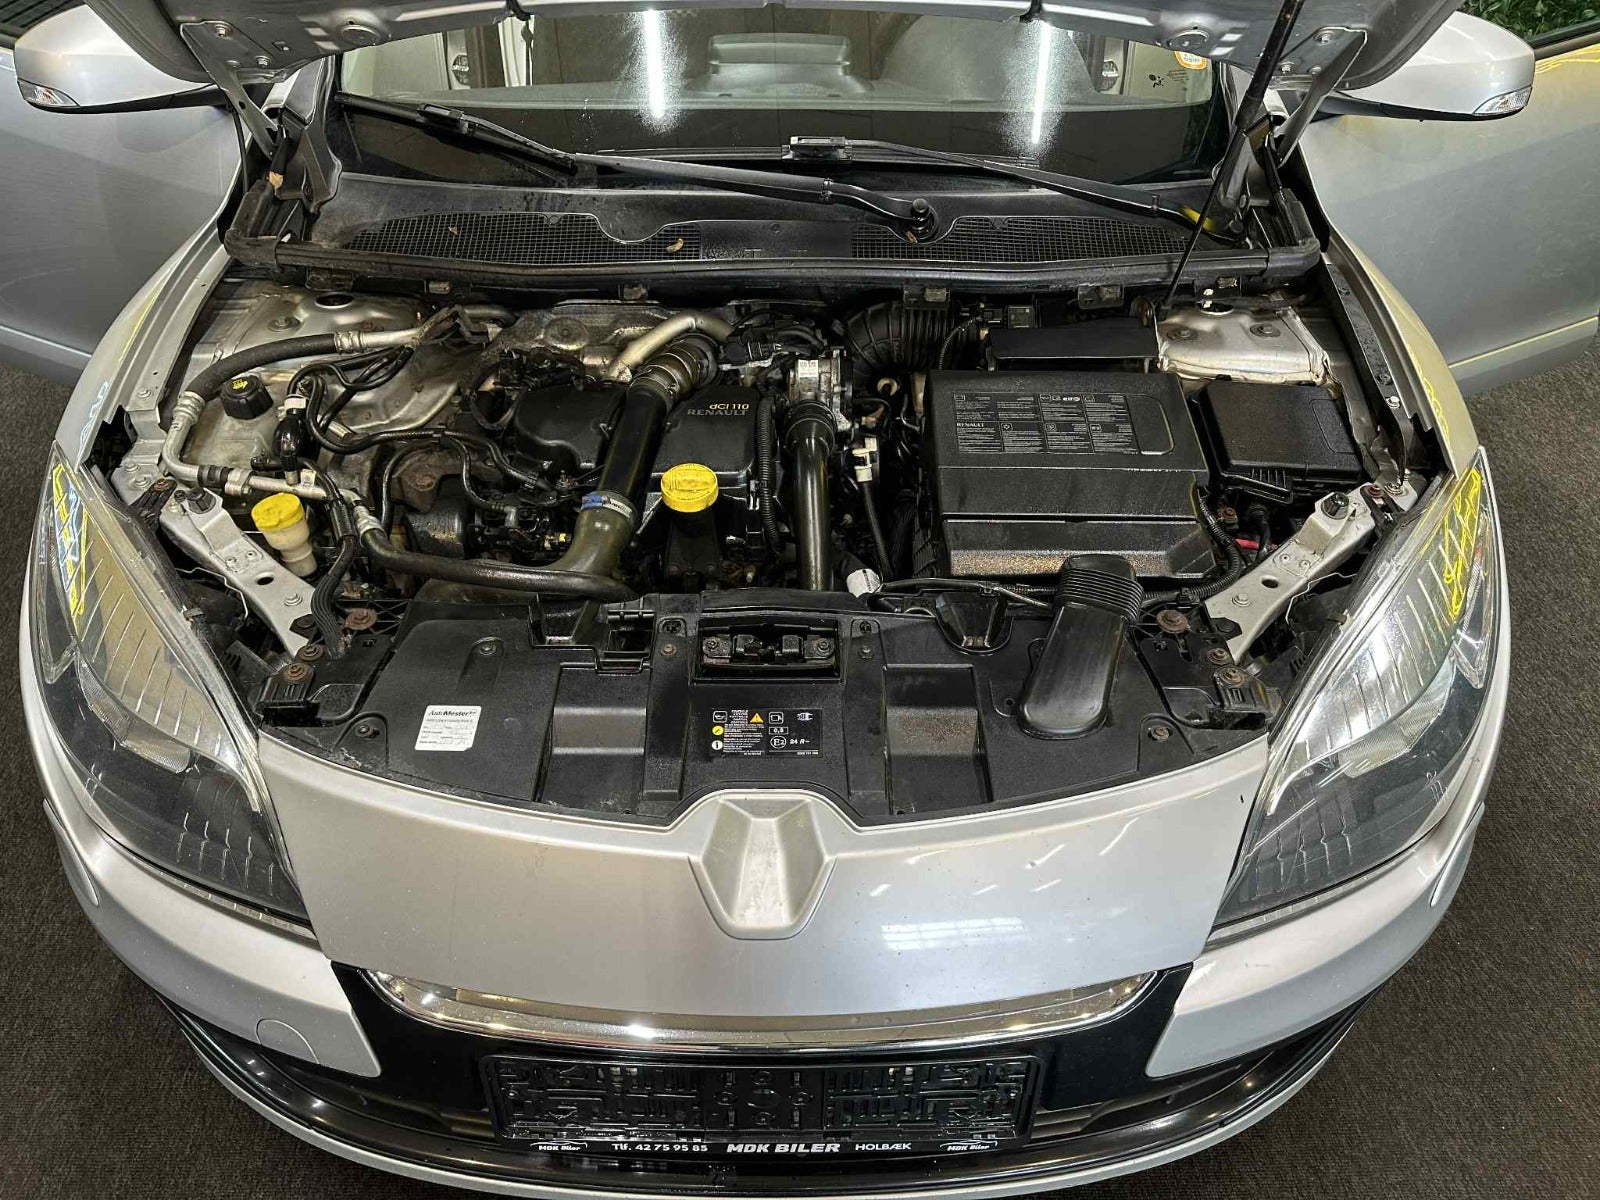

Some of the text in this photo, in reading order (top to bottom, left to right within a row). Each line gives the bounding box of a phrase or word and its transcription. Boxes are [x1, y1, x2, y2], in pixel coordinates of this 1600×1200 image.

[635, 1143, 651, 1151] 42
[654, 1143, 670, 1151] 75
[692, 1144, 708, 1152] 85
[726, 1143, 841, 1153] MDK BILER
[855, 1142, 912, 1151] HOLBÆK
